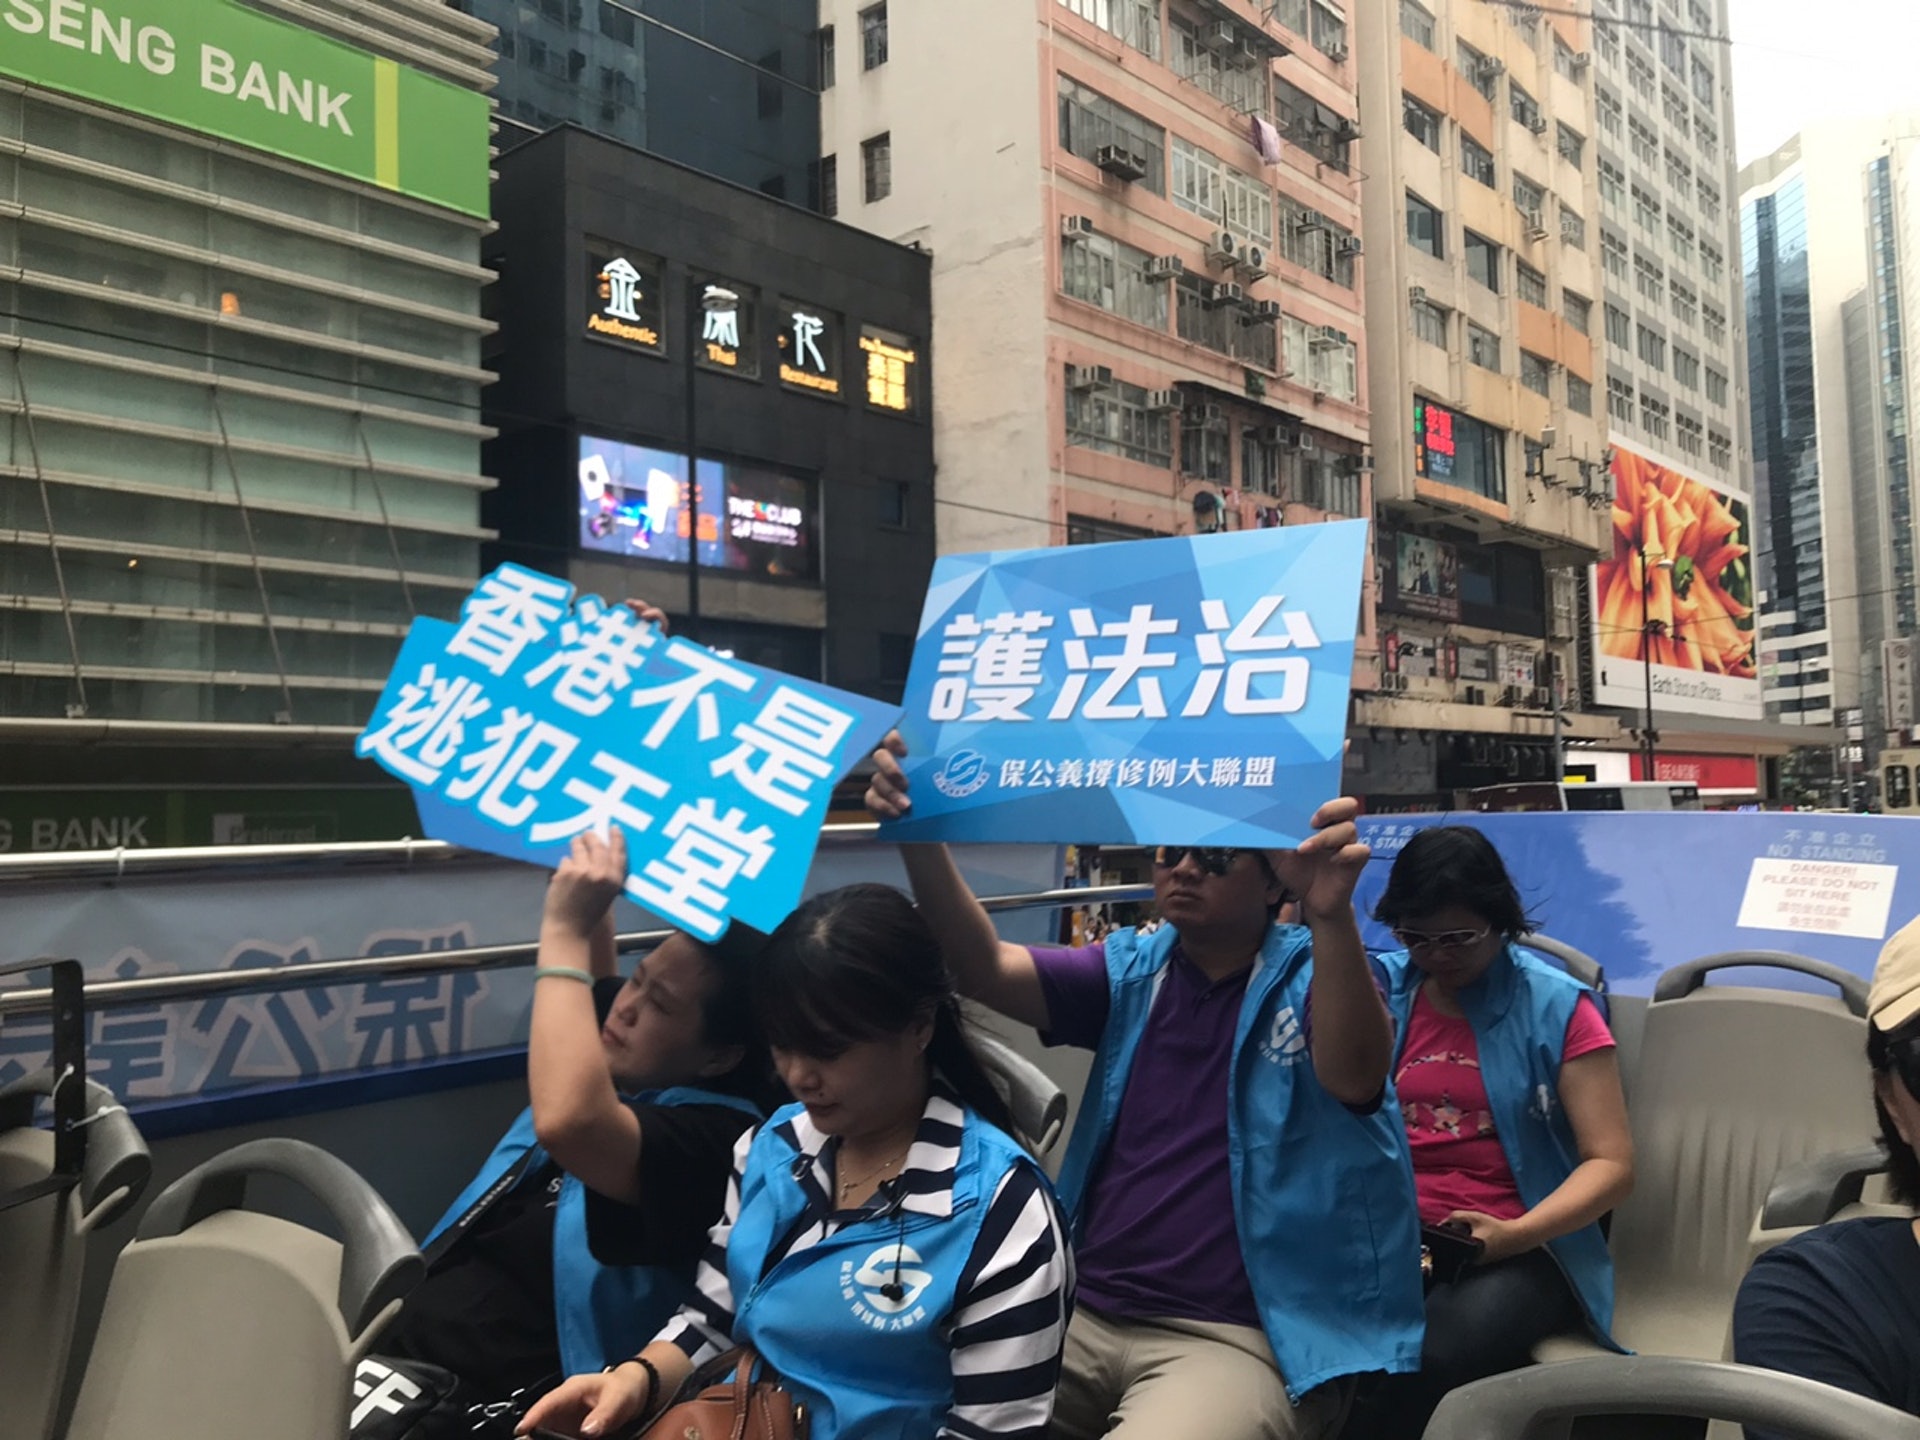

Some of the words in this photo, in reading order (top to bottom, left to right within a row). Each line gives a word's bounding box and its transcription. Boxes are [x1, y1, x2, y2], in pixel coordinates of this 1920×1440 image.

[3, 0, 176, 75] SENG
[200, 43, 354, 136] BANK
[928, 595, 1321, 721] 護法治
[445, 564, 856, 816] 香港不是
[361, 663, 777, 936] 逃犯天堂
[31, 816, 148, 850] BANK
[1768, 844, 1793, 857] NO
[1800, 846, 1887, 863] STANDING
[1790, 863, 1857, 877] DANGER!
[1763, 874, 1818, 886] PLEASE
[1822, 879, 1844, 888] DO
[1848, 880, 1879, 891] NOT
[1784, 888, 1806, 899] SIT
[1810, 890, 1851, 901] HERE
